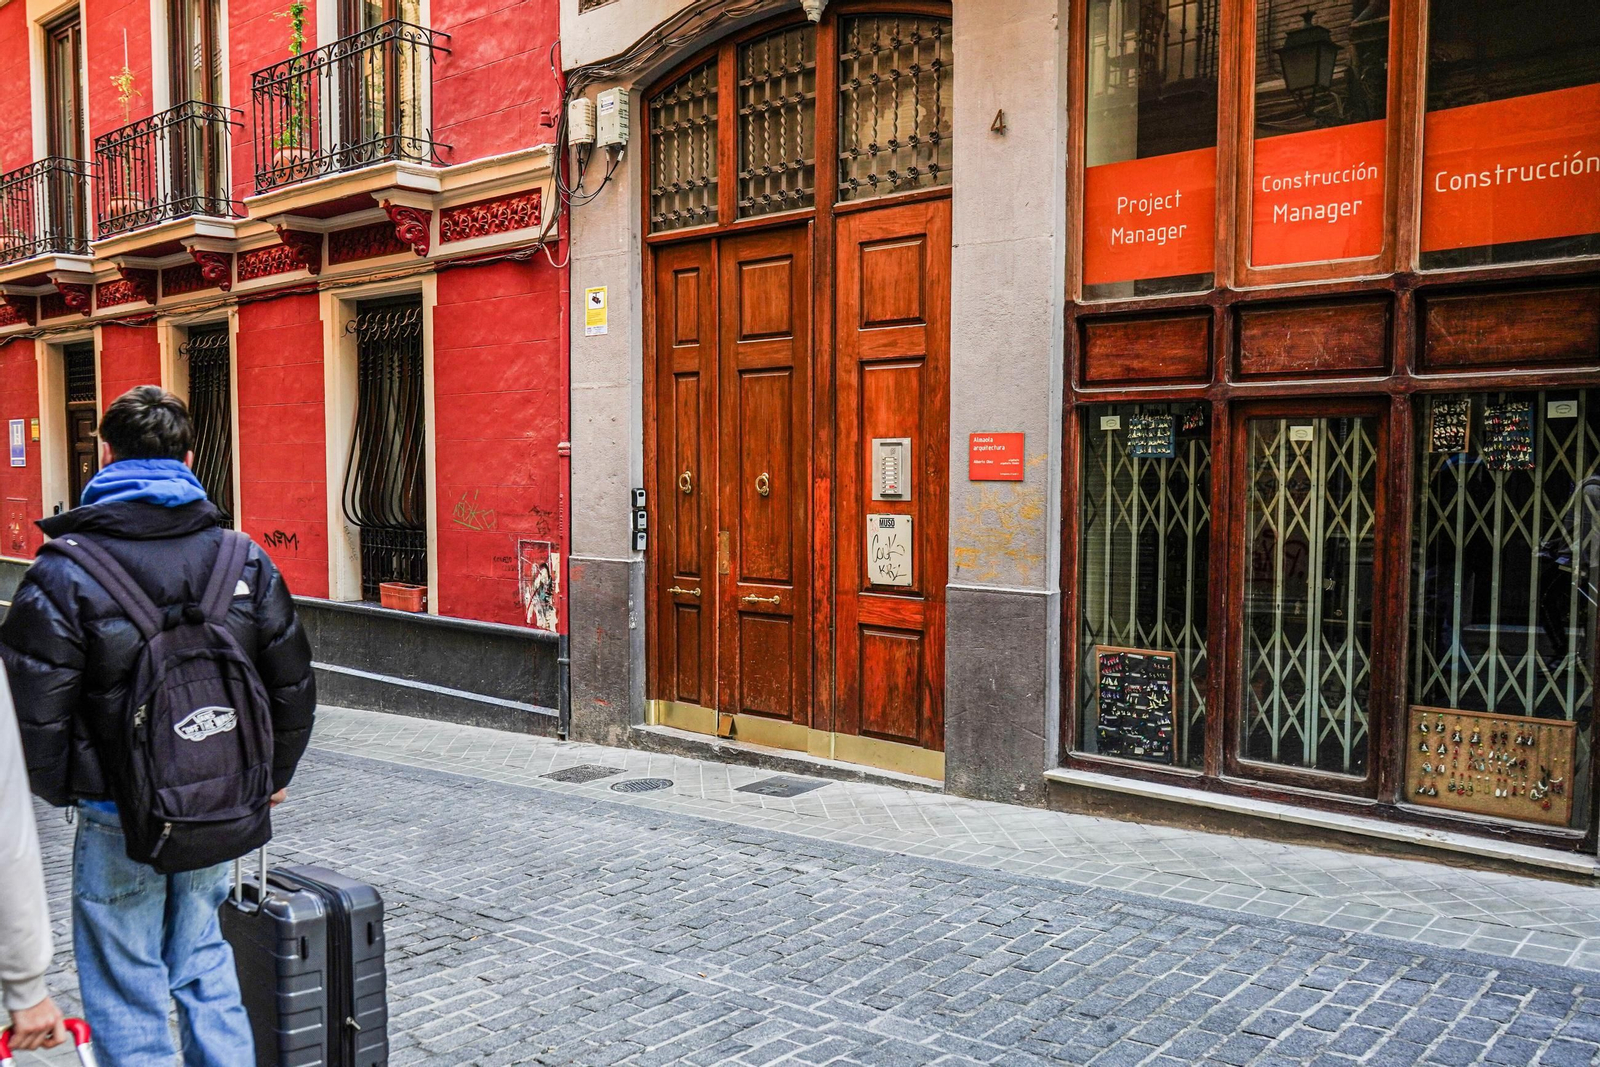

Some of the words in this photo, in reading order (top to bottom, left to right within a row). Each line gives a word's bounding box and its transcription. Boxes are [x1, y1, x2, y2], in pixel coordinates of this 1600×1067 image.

[991, 109, 1006, 135] 4
[1262, 162, 1379, 193] Construcción
[1436, 151, 1599, 193] Construcción
[1117, 190, 1182, 215] Project
[1273, 200, 1362, 224] Manager
[1111, 224, 1187, 246] Manager
